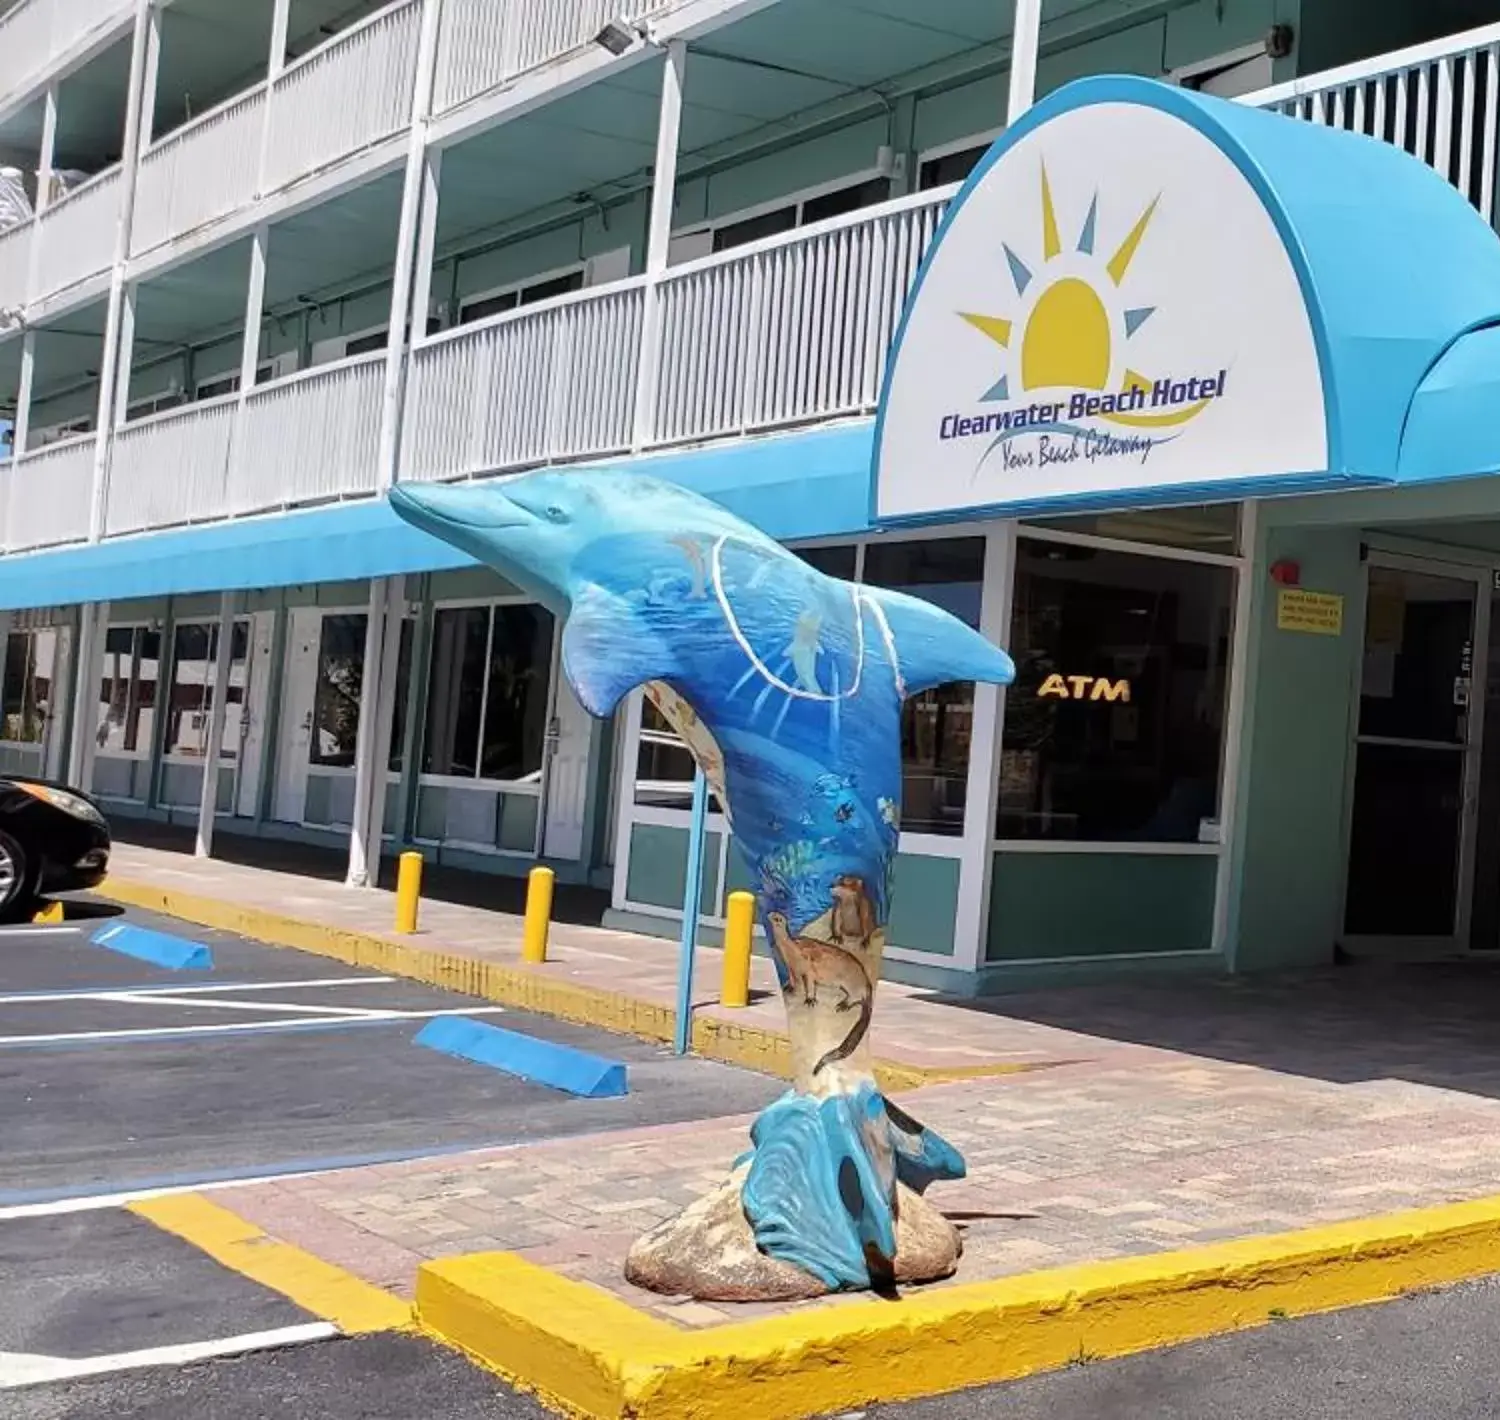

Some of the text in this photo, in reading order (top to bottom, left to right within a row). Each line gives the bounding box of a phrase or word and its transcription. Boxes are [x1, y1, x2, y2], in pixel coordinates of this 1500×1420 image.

[940, 369, 1227, 440] Clearwater Beach Hotel
[1001, 427, 1152, 471] Your Beach Getaway
[1037, 672, 1131, 702] ATM
